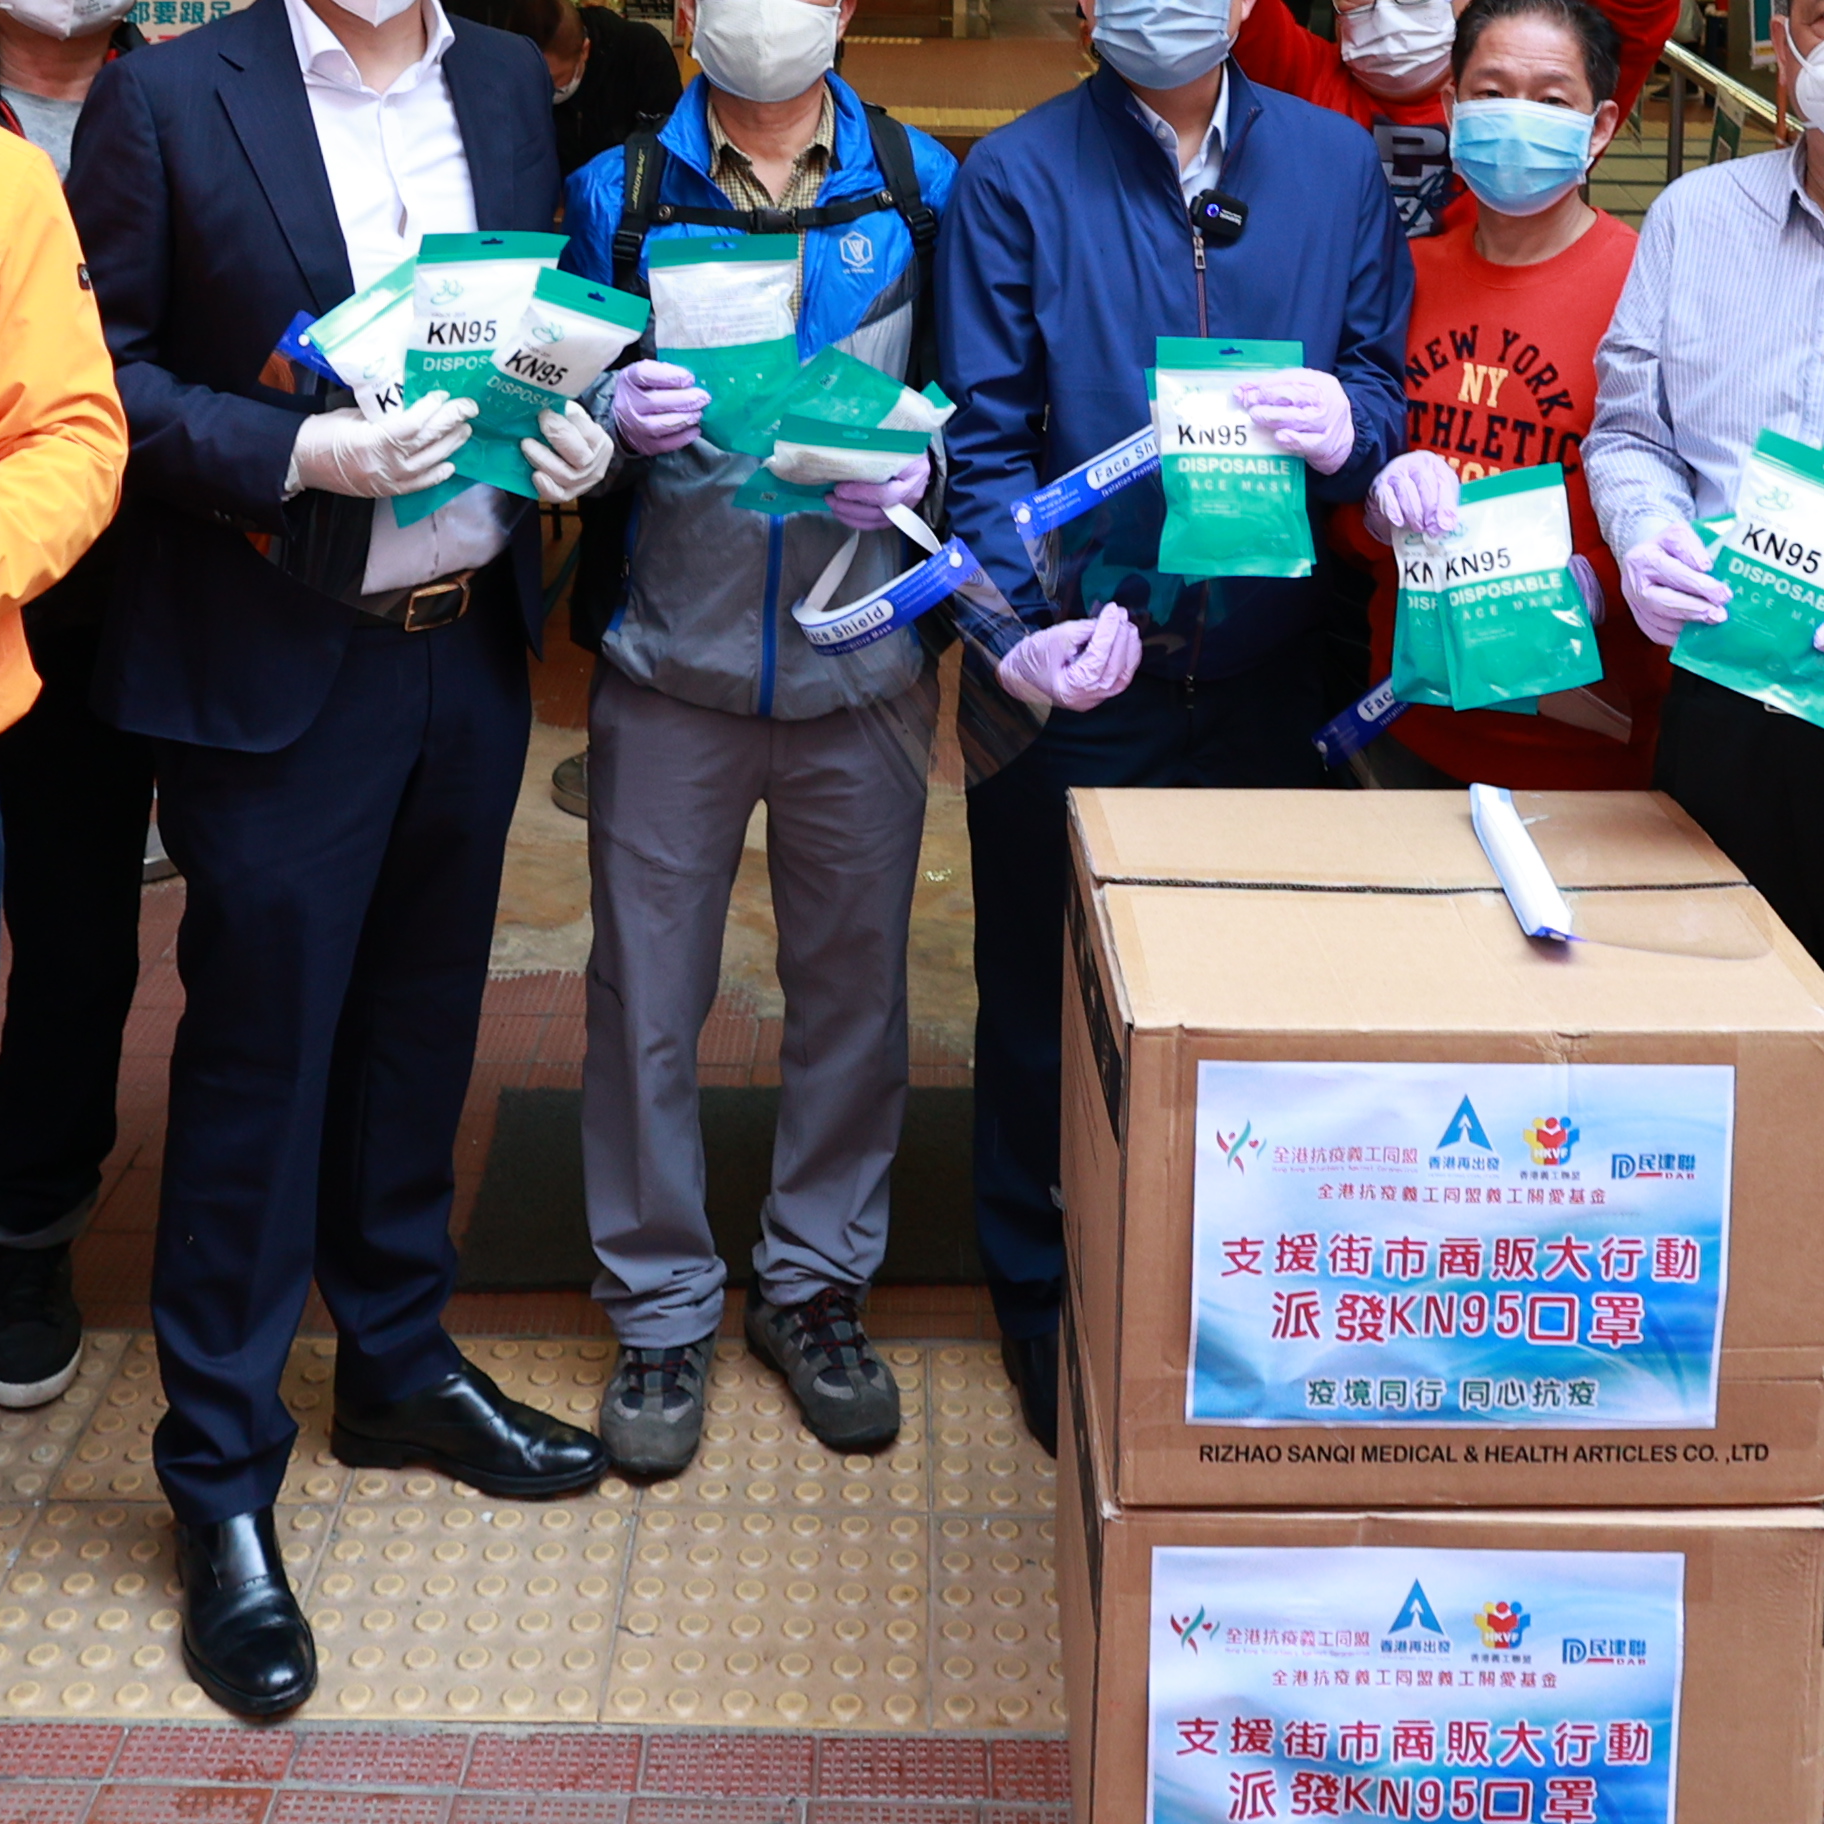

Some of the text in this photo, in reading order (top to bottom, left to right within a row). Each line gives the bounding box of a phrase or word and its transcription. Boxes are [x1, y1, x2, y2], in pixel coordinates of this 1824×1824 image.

[427, 320, 497, 347] KN95
[505, 348, 568, 388] KN95
[1406, 324, 1575, 420] NEW YORK
[1457, 362, 1509, 409] NY
[1177, 424, 1248, 446] KN95
[1094, 456, 1132, 484] Face
[1177, 457, 1291, 476] DISPOSABLE
[1241, 479, 1292, 493] MASK
[1740, 522, 1824, 575] KN95
[1445, 547, 1512, 581] KN95
[1448, 572, 1563, 607] DISPOSABLE
[1513, 594, 1565, 612] MASK
[834, 605, 886, 638] Shield
[872, 624, 894, 640] Mask
[1272, 1146, 1419, 1166] 全港抗疫義工同盟
[1428, 1155, 1501, 1172] 香港再出發
[1533, 1147, 1569, 1159] HKVF
[1638, 1153, 1696, 1171] 民建聯
[1317, 1183, 1607, 1205] 全港抗疫義工同盟義工關愛基金
[1220, 1232, 1702, 1283] 支援街市商販大行動
[1270, 1290, 1647, 1348] 派發KN95口罩
[1306, 1378, 1598, 1410] 疫境同行 同心抗疫
[1198, 1442, 1283, 1464] RIZHAO
[1286, 1442, 1357, 1464] SANQI
[1361, 1442, 1460, 1464] MEDICAL
[1464, 1442, 1480, 1464] &
[1483, 1442, 1568, 1464] HEALTH
[1573, 1442, 1678, 1464] ARTICLES
[1682, 1441, 1720, 1463] CO.
[1225, 1628, 1371, 1649] 全港抗疫義工同盟
[1380, 1639, 1452, 1654] 香港再出發
[1485, 1632, 1519, 1643] HKVF
[1589, 1638, 1647, 1656] 民建聯
[1271, 1669, 1559, 1689] 全港抗疫義工同盟義工關愛基金
[1176, 1717, 1653, 1767] 支援街市商販大行動
[1228, 1769, 1598, 1824] 派發KN95口罩
